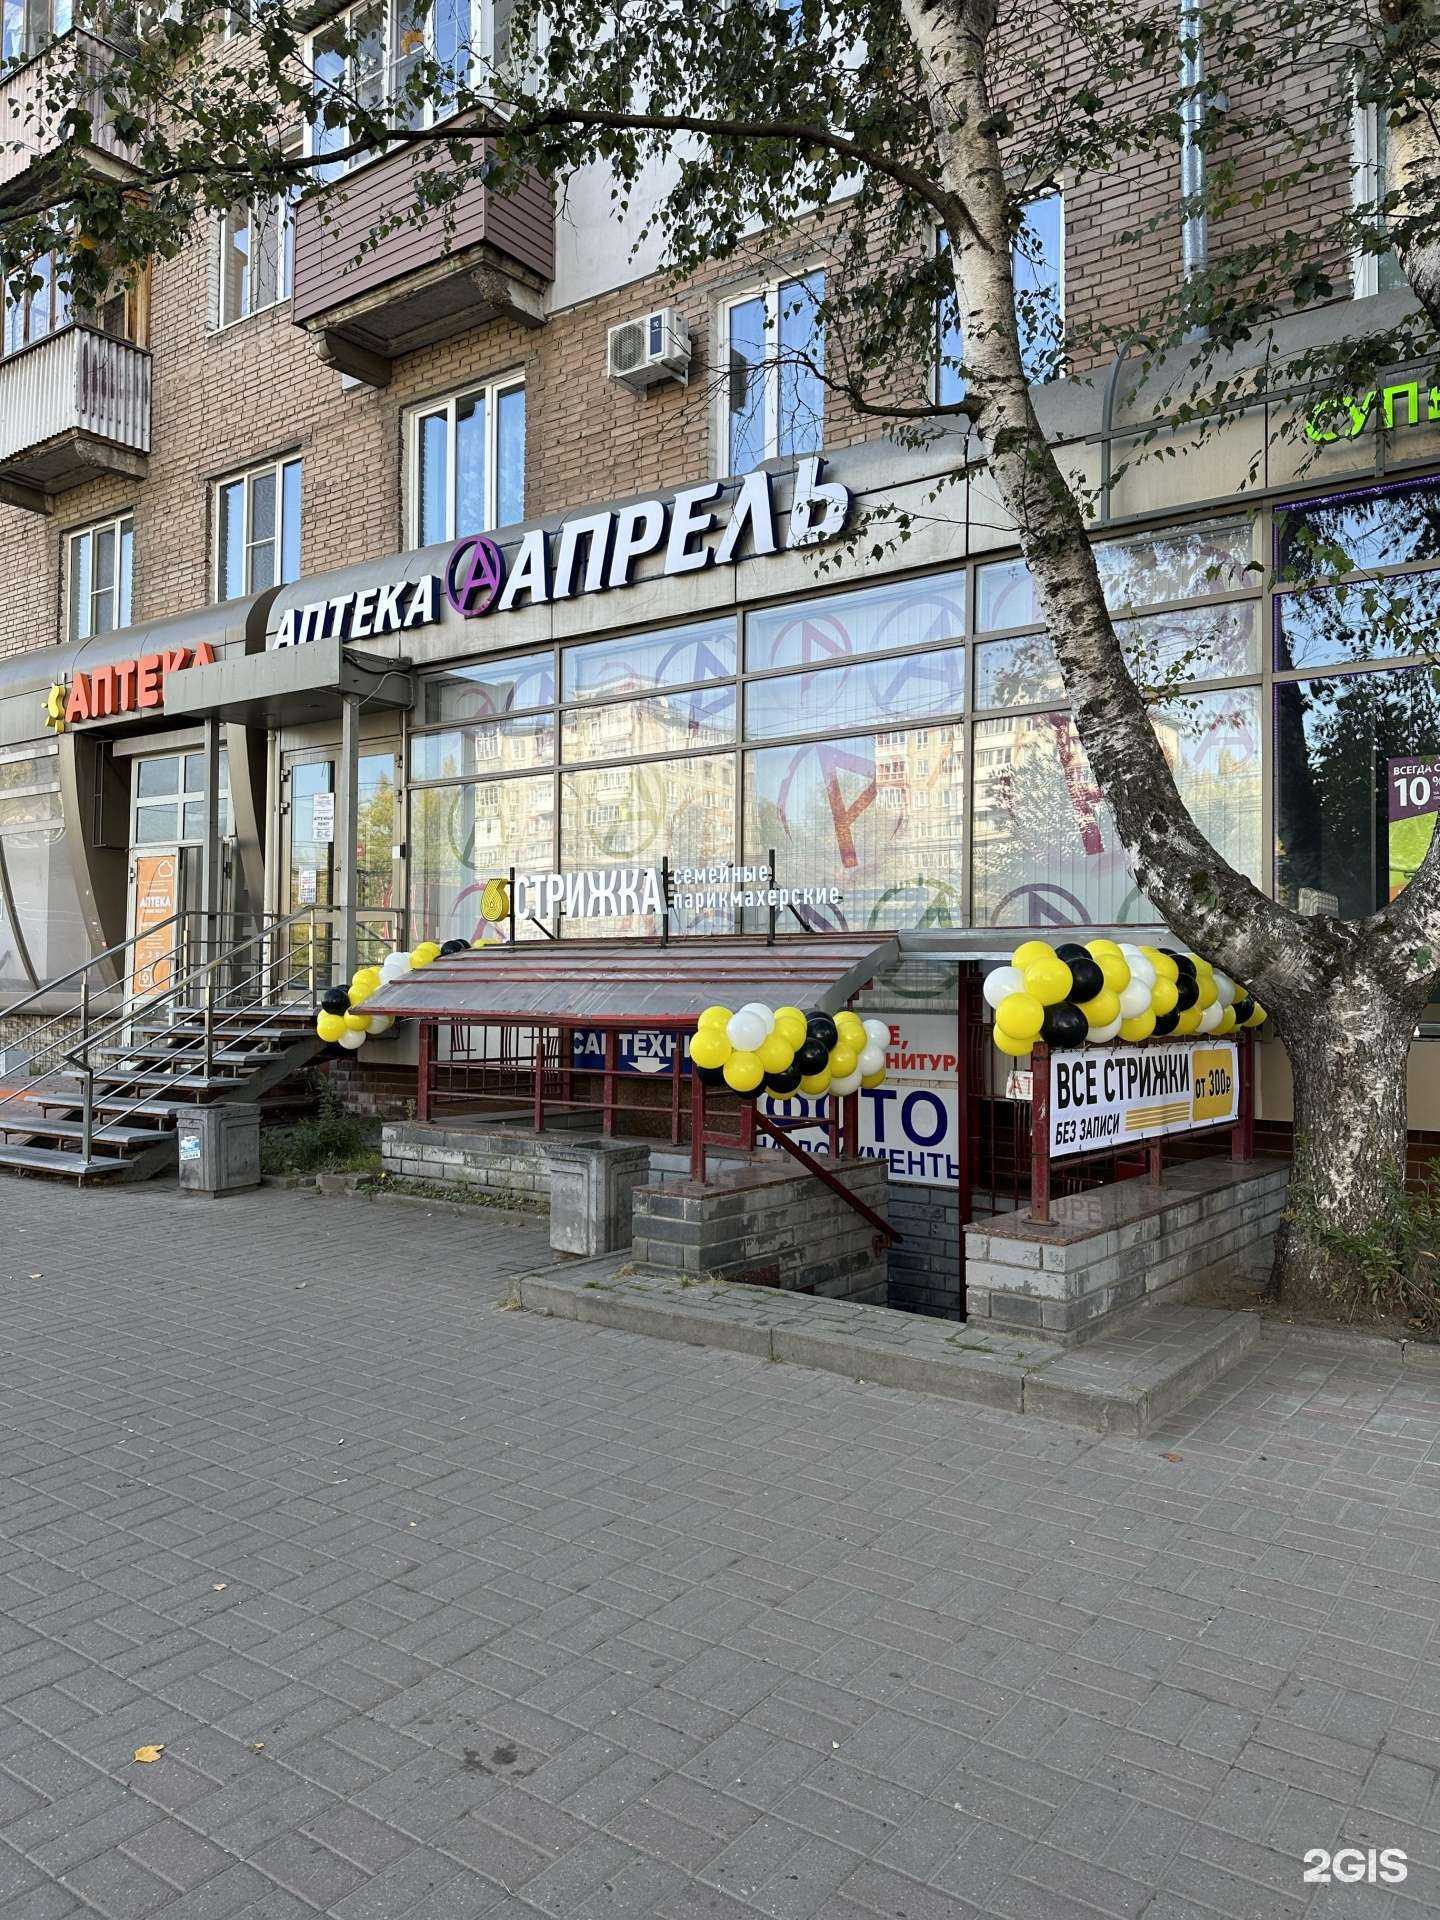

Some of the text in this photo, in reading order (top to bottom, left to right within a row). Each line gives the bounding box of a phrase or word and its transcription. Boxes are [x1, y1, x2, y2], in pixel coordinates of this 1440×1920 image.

[272, 575, 436, 650] АПТЕКА
[499, 456, 850, 612] АПРЕЛЬ
[1393, 764, 1432, 776] ВСЕГДА
[673, 861, 771, 885] семейные
[514, 867, 665, 920] СТРИЖКА
[673, 885, 840, 914] парикмахерские
[886, 1053, 958, 1072] НИТУР
[1056, 1053, 1190, 1110] ВСЕ СТРИЖКИ
[1055, 1113, 1120, 1146] БЕЗ ЗАПИСИ
